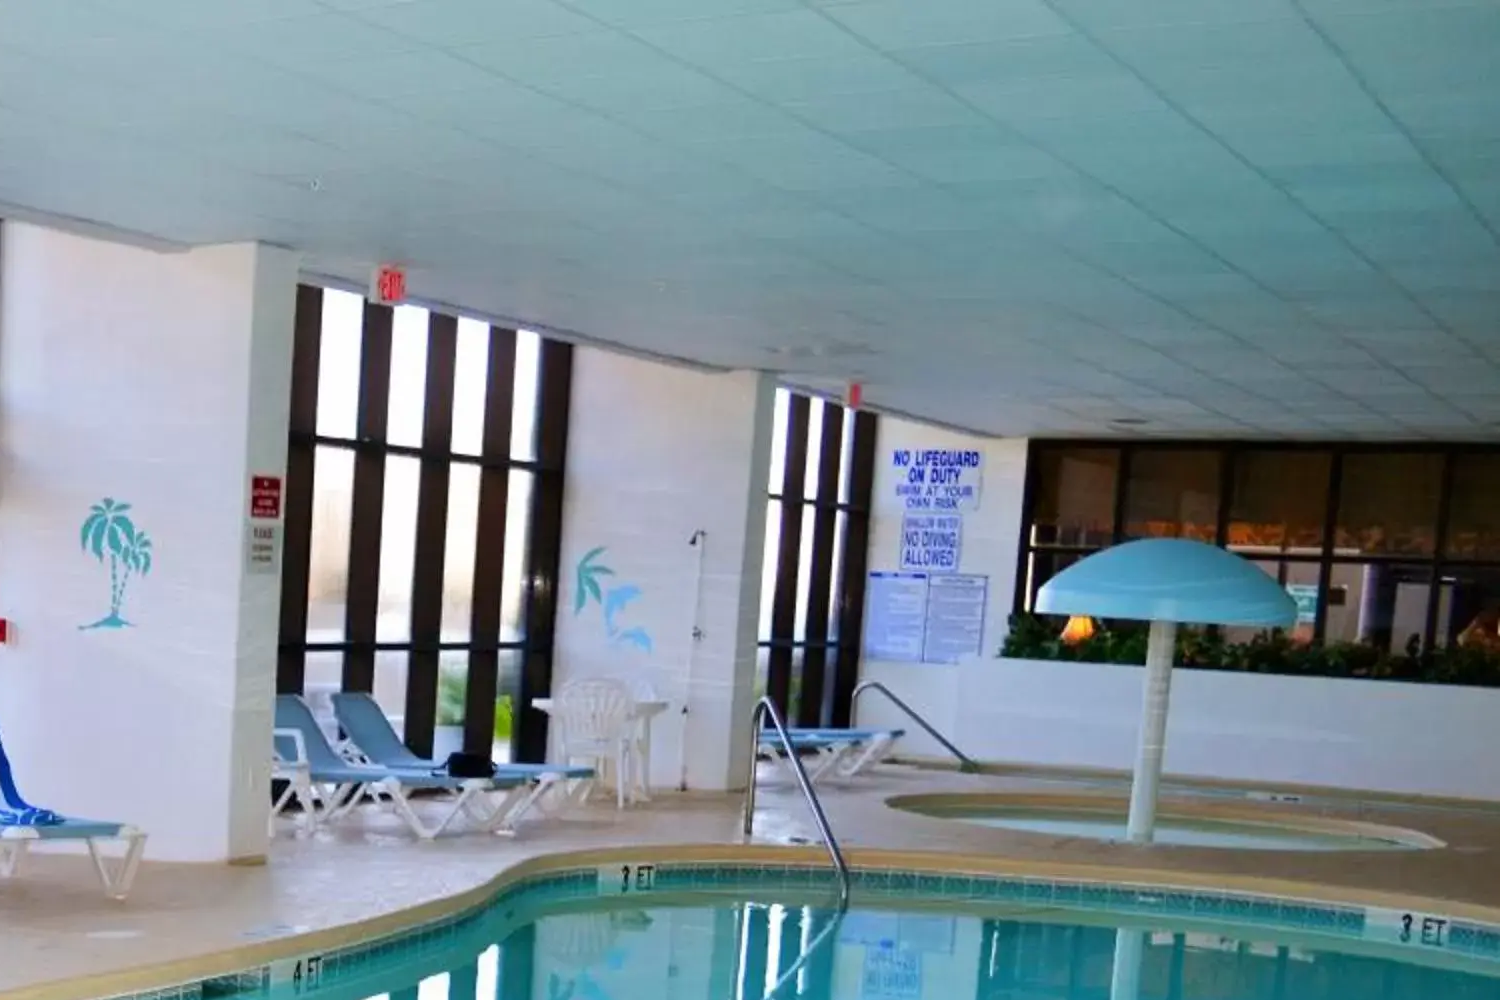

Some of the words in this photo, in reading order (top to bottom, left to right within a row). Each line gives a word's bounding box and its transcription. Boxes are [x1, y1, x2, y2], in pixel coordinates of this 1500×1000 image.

[894, 450, 910, 466] NO
[915, 450, 979, 468] LIFEGUARD
[908, 467, 925, 483] ON
[930, 467, 960, 484] DUTY
[926, 485, 940, 496] AT
[905, 531, 919, 547] NO
[922, 531, 956, 548] DIVING
[904, 549, 954, 567] ALLOWED
[293, 959, 302, 981] 4
